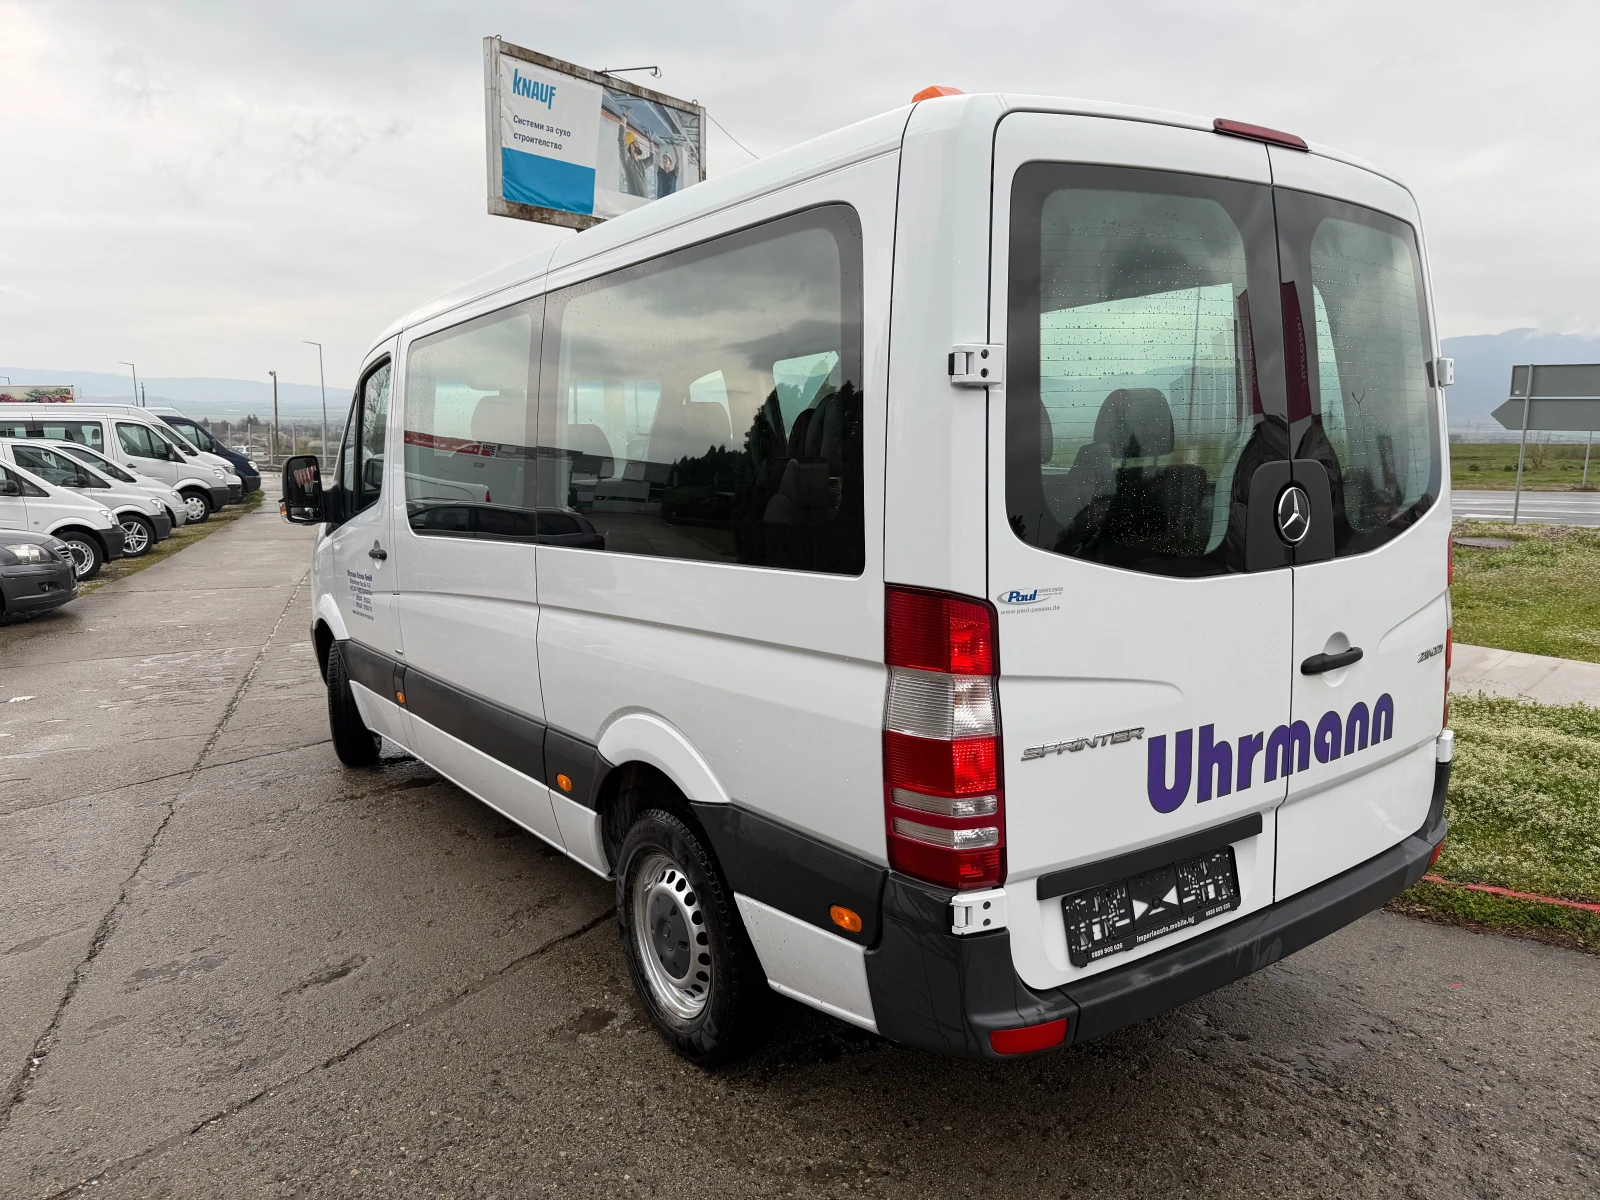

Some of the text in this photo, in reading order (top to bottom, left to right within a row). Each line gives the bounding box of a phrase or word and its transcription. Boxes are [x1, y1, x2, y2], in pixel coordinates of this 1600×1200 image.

[513, 68, 556, 110] KNAUF
[513, 115, 571, 138] Системи за сухо
[513, 132, 563, 151] строителство
[1007, 589, 1038, 603] Paul
[1021, 726, 1145, 761] SPRINTER
[1147, 692, 1394, 814] Uhrmann
